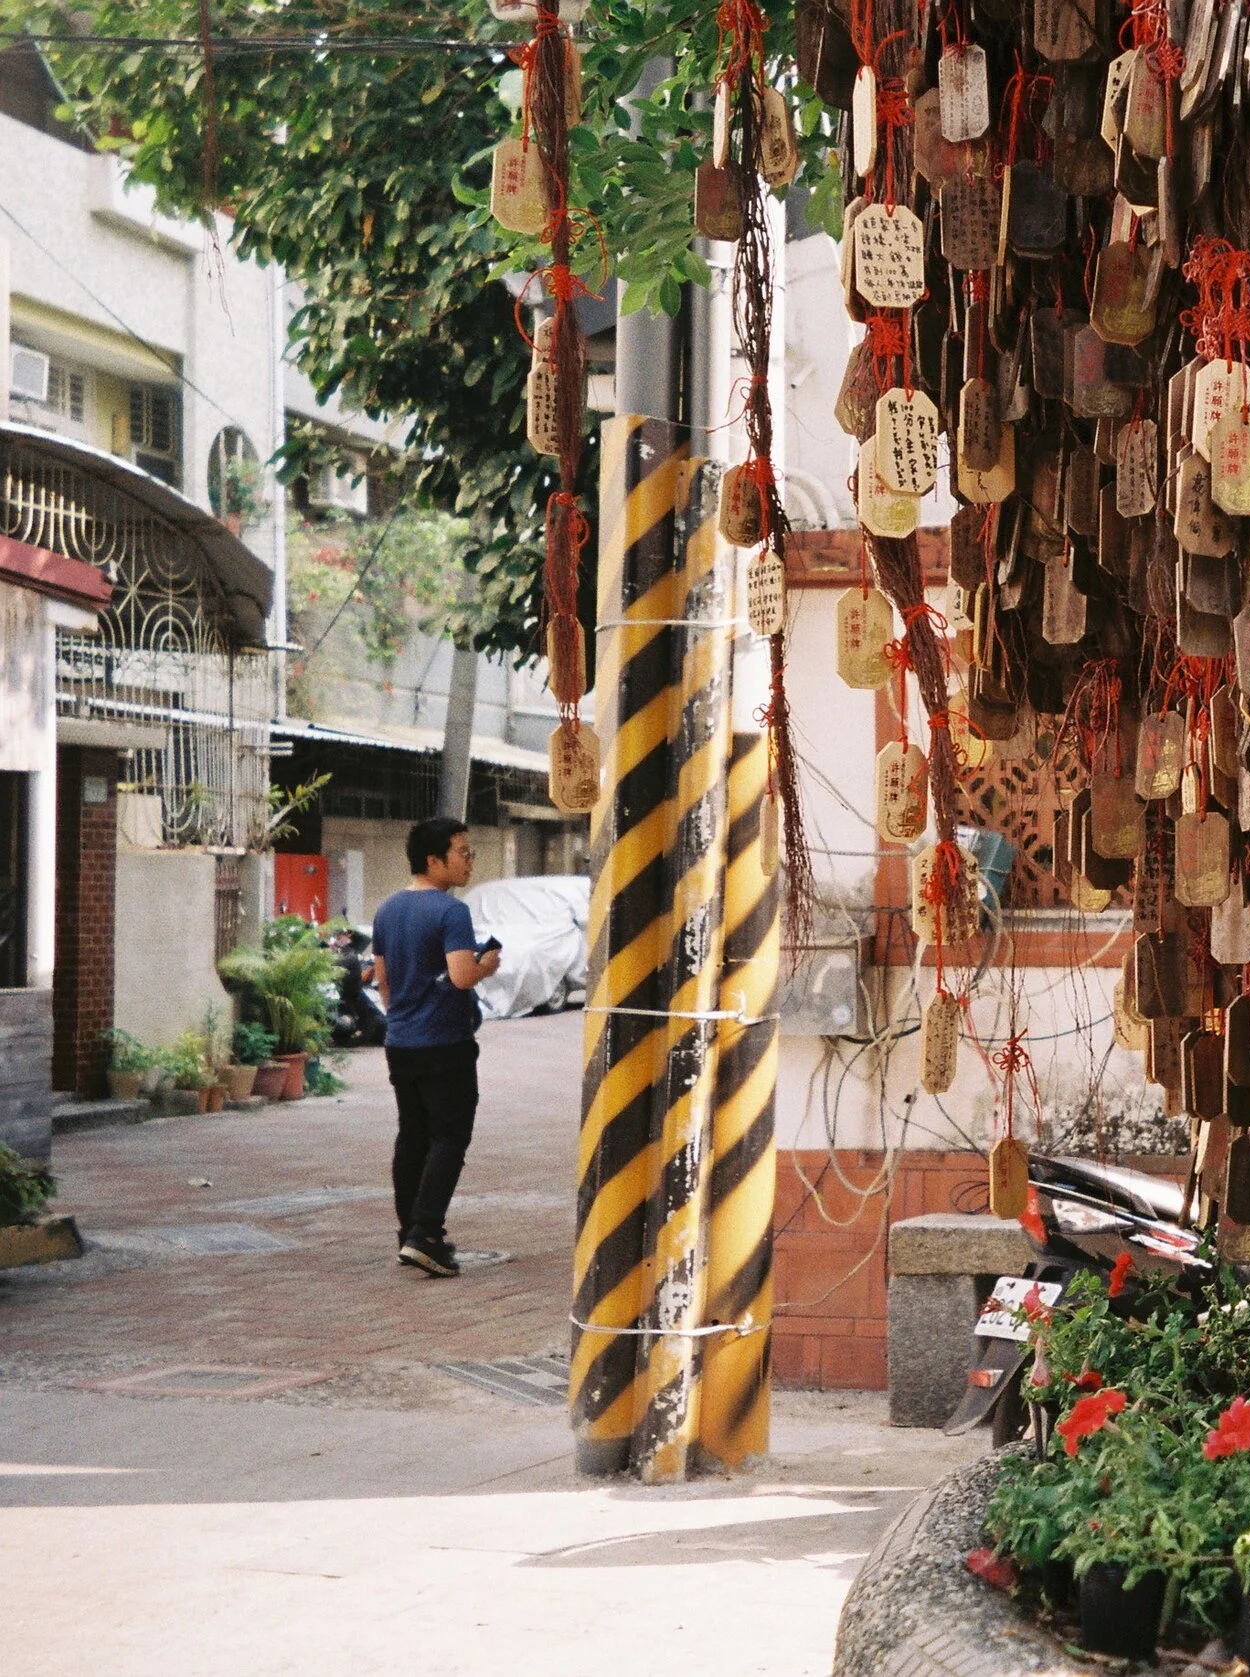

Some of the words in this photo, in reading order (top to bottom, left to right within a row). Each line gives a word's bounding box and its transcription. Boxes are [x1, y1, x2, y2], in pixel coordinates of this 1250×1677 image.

[1211, 379, 1223, 422] 許願牌
[889, 761, 900, 803] 許願牌
